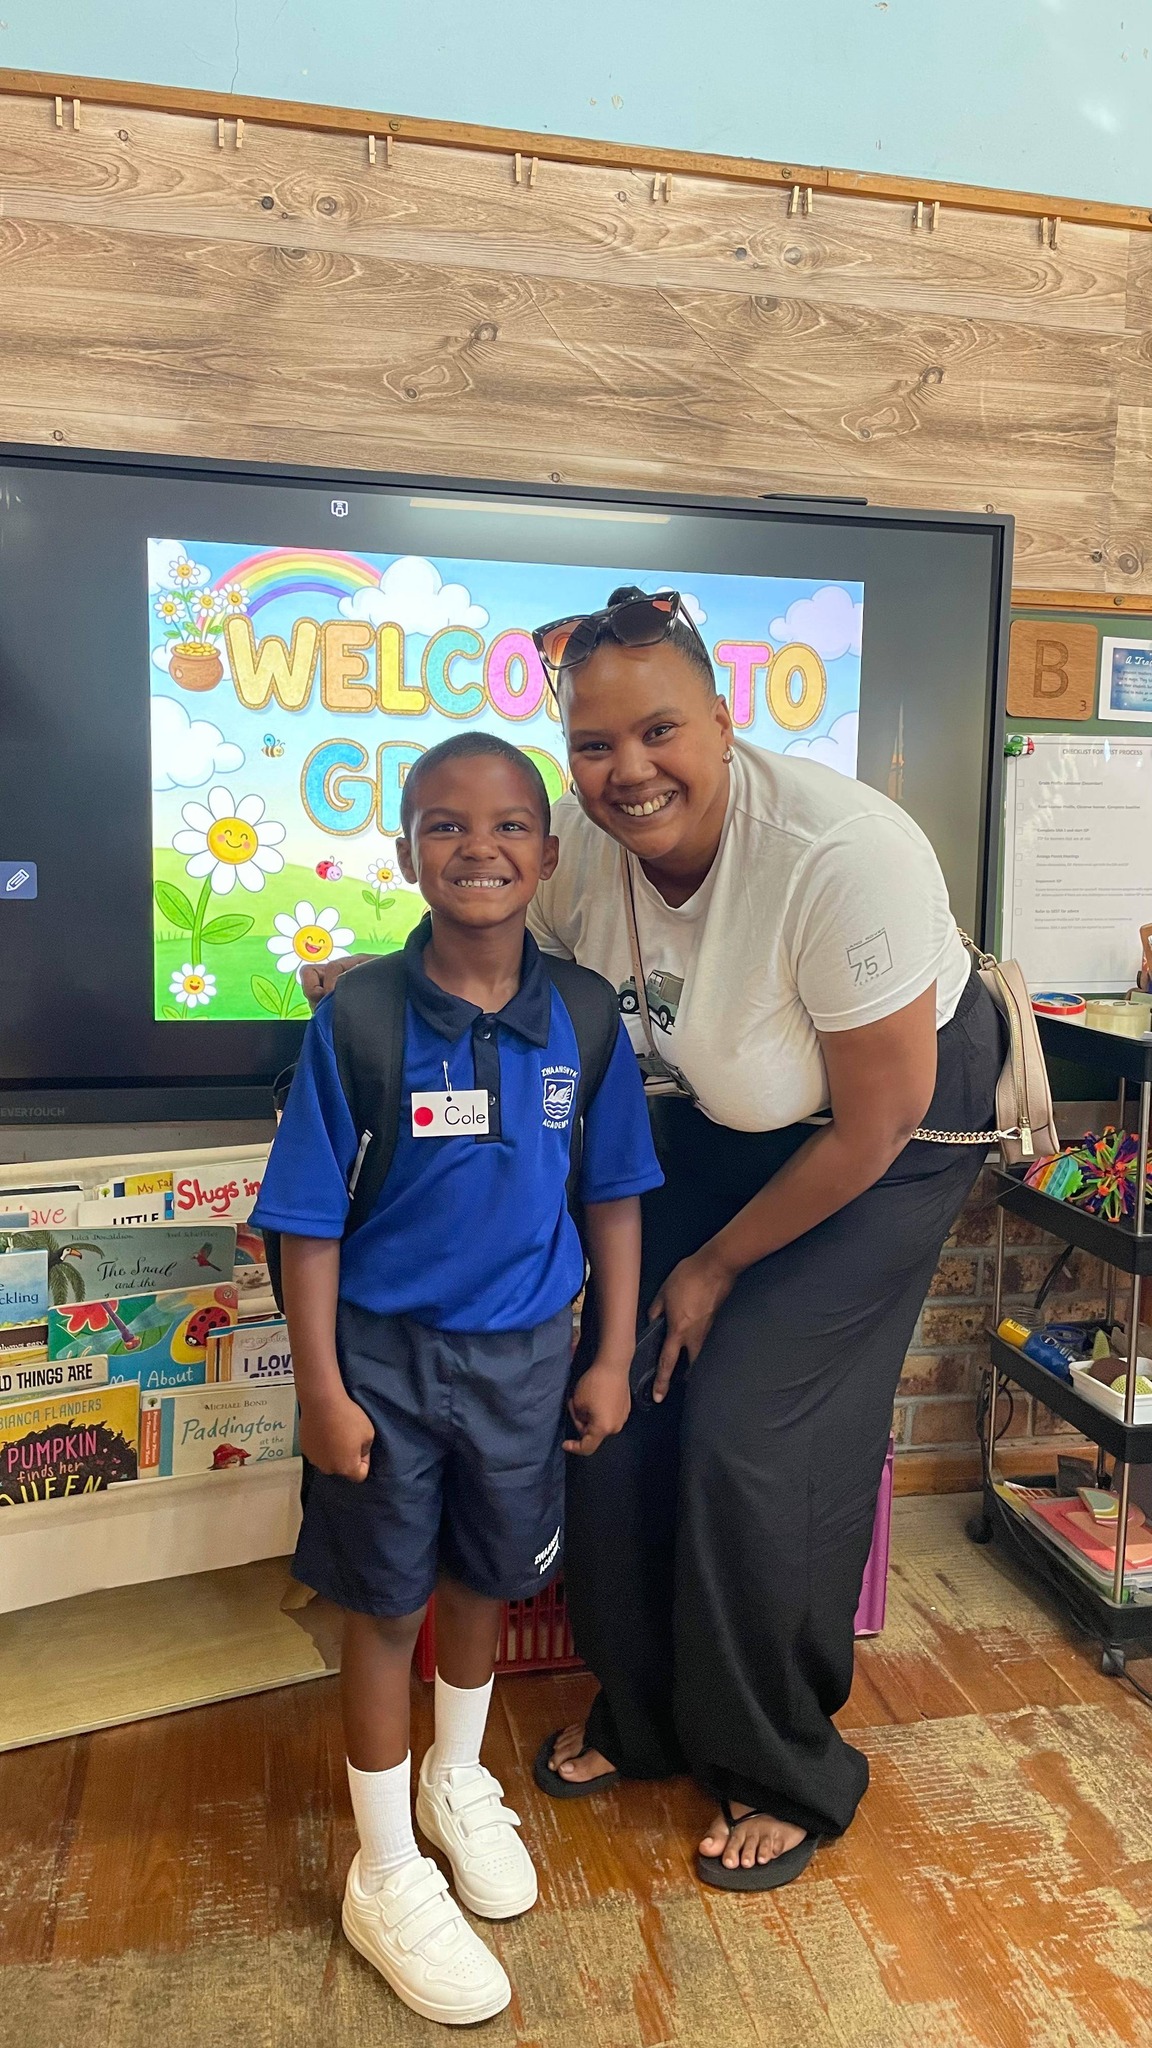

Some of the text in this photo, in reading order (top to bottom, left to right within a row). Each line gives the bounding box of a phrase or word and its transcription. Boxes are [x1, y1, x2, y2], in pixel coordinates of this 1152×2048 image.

[224, 614, 827, 731] WELCO TO
[1033, 639, 1069, 699] B
[1080, 699, 1087, 712] 3
[850, 954, 878, 983] 75
[444, 1104, 486, 1126] Cole
[137, 1182, 155, 1196] My
[177, 1178, 239, 1213] Slugs
[97, 1256, 178, 1281] The Snail
[244, 1353, 292, 1373] I LOV
[16, 1367, 64, 1389] THINGS
[67, 1363, 93, 1382] ARE
[147, 1366, 194, 1387] About
[44, 1398, 102, 1421] FLANDERS
[243, 1400, 268, 1408] BOND
[181, 1415, 287, 1446] Paddington
[7, 1430, 97, 1474] PUMPKIN
[256, 1446, 284, 1462] Zoo
[17, 1460, 85, 1484] finds her
